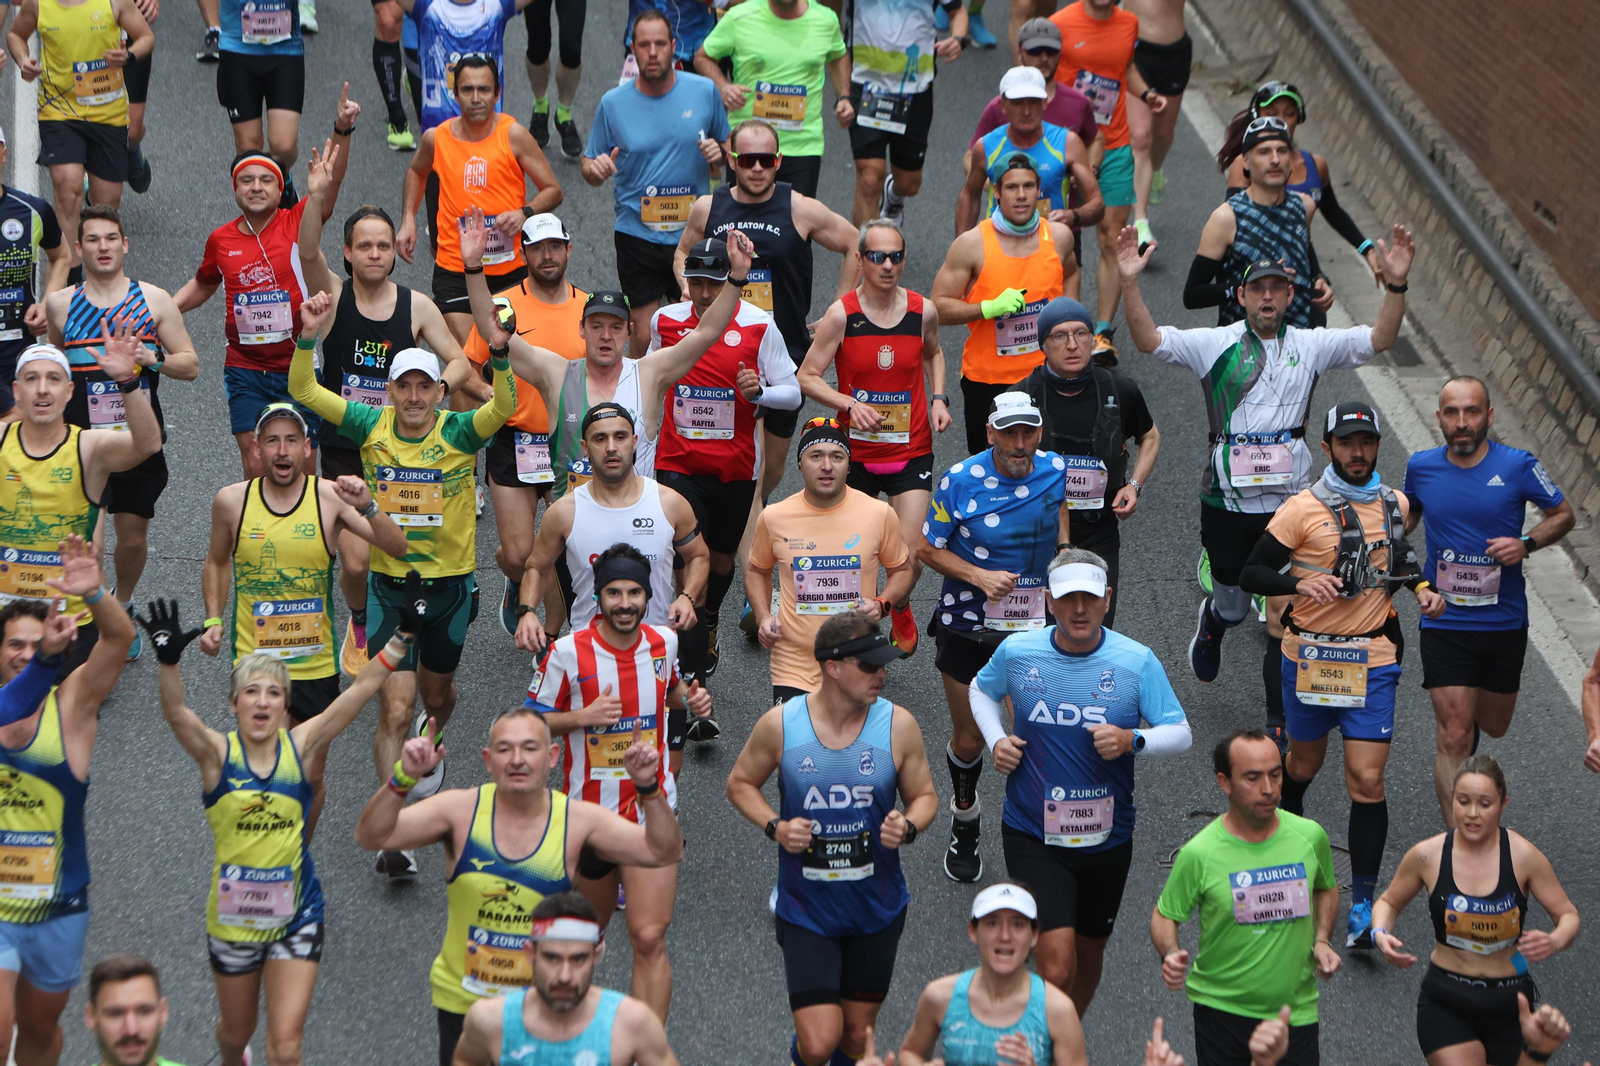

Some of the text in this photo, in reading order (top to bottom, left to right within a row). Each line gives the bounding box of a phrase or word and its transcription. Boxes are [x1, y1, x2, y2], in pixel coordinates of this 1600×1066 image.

[773, 85, 802, 94] ZURICH
[660, 186, 691, 195] ZURICH
[660, 202, 679, 210] 5033
[713, 222, 735, 236] LONG
[738, 222, 764, 230] EATON
[250, 294, 283, 302] ZURICH
[252, 310, 272, 320] 7942
[255, 324, 266, 332] DR.
[1014, 322, 1034, 332] 6811
[1014, 334, 1038, 344] POYATO
[694, 390, 728, 398] ZURICH
[872, 394, 905, 402] ZURICH
[362, 395, 382, 406] 7320
[692, 406, 714, 415] 6542
[878, 410, 891, 418] 77
[692, 420, 716, 428] RAFITA
[1250, 452, 1272, 460] 6973
[1068, 458, 1101, 467] ZURICH
[398, 472, 434, 481] ZURICH
[1066, 476, 1086, 485] 7441
[398, 490, 420, 499] 4016
[400, 505, 419, 513] NENE
[22, 552, 61, 563] ZURICH
[816, 558, 852, 567] ZURICH
[1458, 554, 1494, 564] ZURICH
[20, 572, 44, 582] 5194
[1456, 572, 1478, 581] 6435
[816, 578, 839, 587] 7936
[1452, 585, 1482, 594] ANDRES
[798, 592, 859, 601] SÉRGIO MOREIRA
[1009, 596, 1029, 604] 7110
[277, 602, 315, 612] ZURICH
[1004, 610, 1029, 618] CARLOS
[278, 622, 301, 632] 4018
[259, 636, 320, 647] DAVID CALVENTE
[1322, 650, 1360, 660] ZURICH
[1320, 669, 1343, 679] 5543
[1310, 684, 1339, 692] MIKELO
[1028, 700, 1109, 728] ADS
[611, 718, 650, 730] ZURH
[802, 784, 875, 810] ADS
[1070, 786, 1108, 798] ZURICH
[1069, 808, 1093, 818] 7883
[826, 820, 864, 834] ZURICH
[3, 832, 48, 845] ZURICH
[826, 843, 852, 855] 2740
[828, 858, 851, 868] YNSA
[244, 869, 286, 881] ZURICH
[1257, 867, 1297, 882] ZURICH
[1259, 892, 1284, 904] 6828
[1472, 898, 1512, 913] ZURICH
[1254, 909, 1293, 920] CARLITOS
[1472, 922, 1498, 931] 5010
